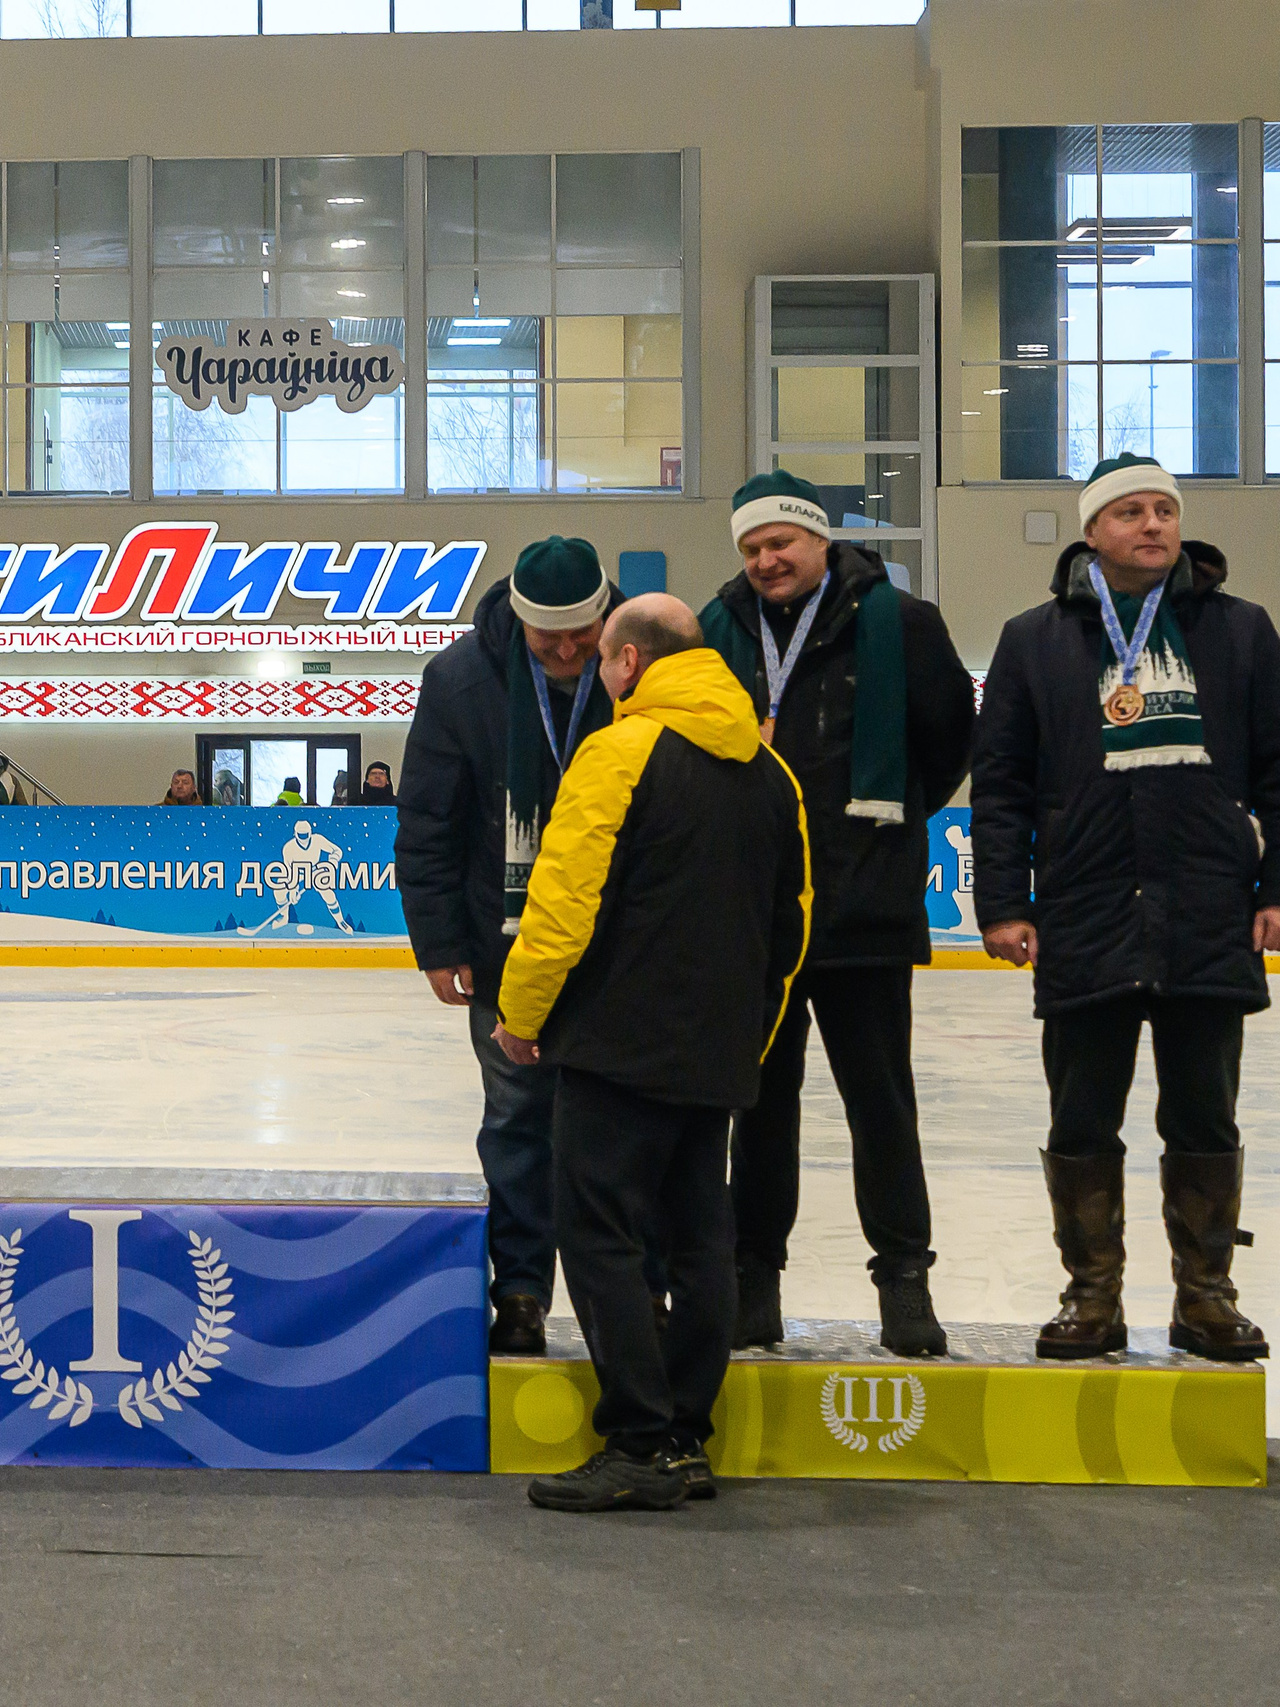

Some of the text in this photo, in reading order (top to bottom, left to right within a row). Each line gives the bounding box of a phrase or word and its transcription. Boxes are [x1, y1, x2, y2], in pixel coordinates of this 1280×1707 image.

[237, 328, 322, 347] КАФЕ
[166, 346, 395, 403] Чараўніца
[182, 626, 396, 646] ГОРНОЛЫЖНЫЙ
[235, 860, 398, 898] делами
[68, 1209, 143, 1373] I
[838, 1376, 910, 1423] III
